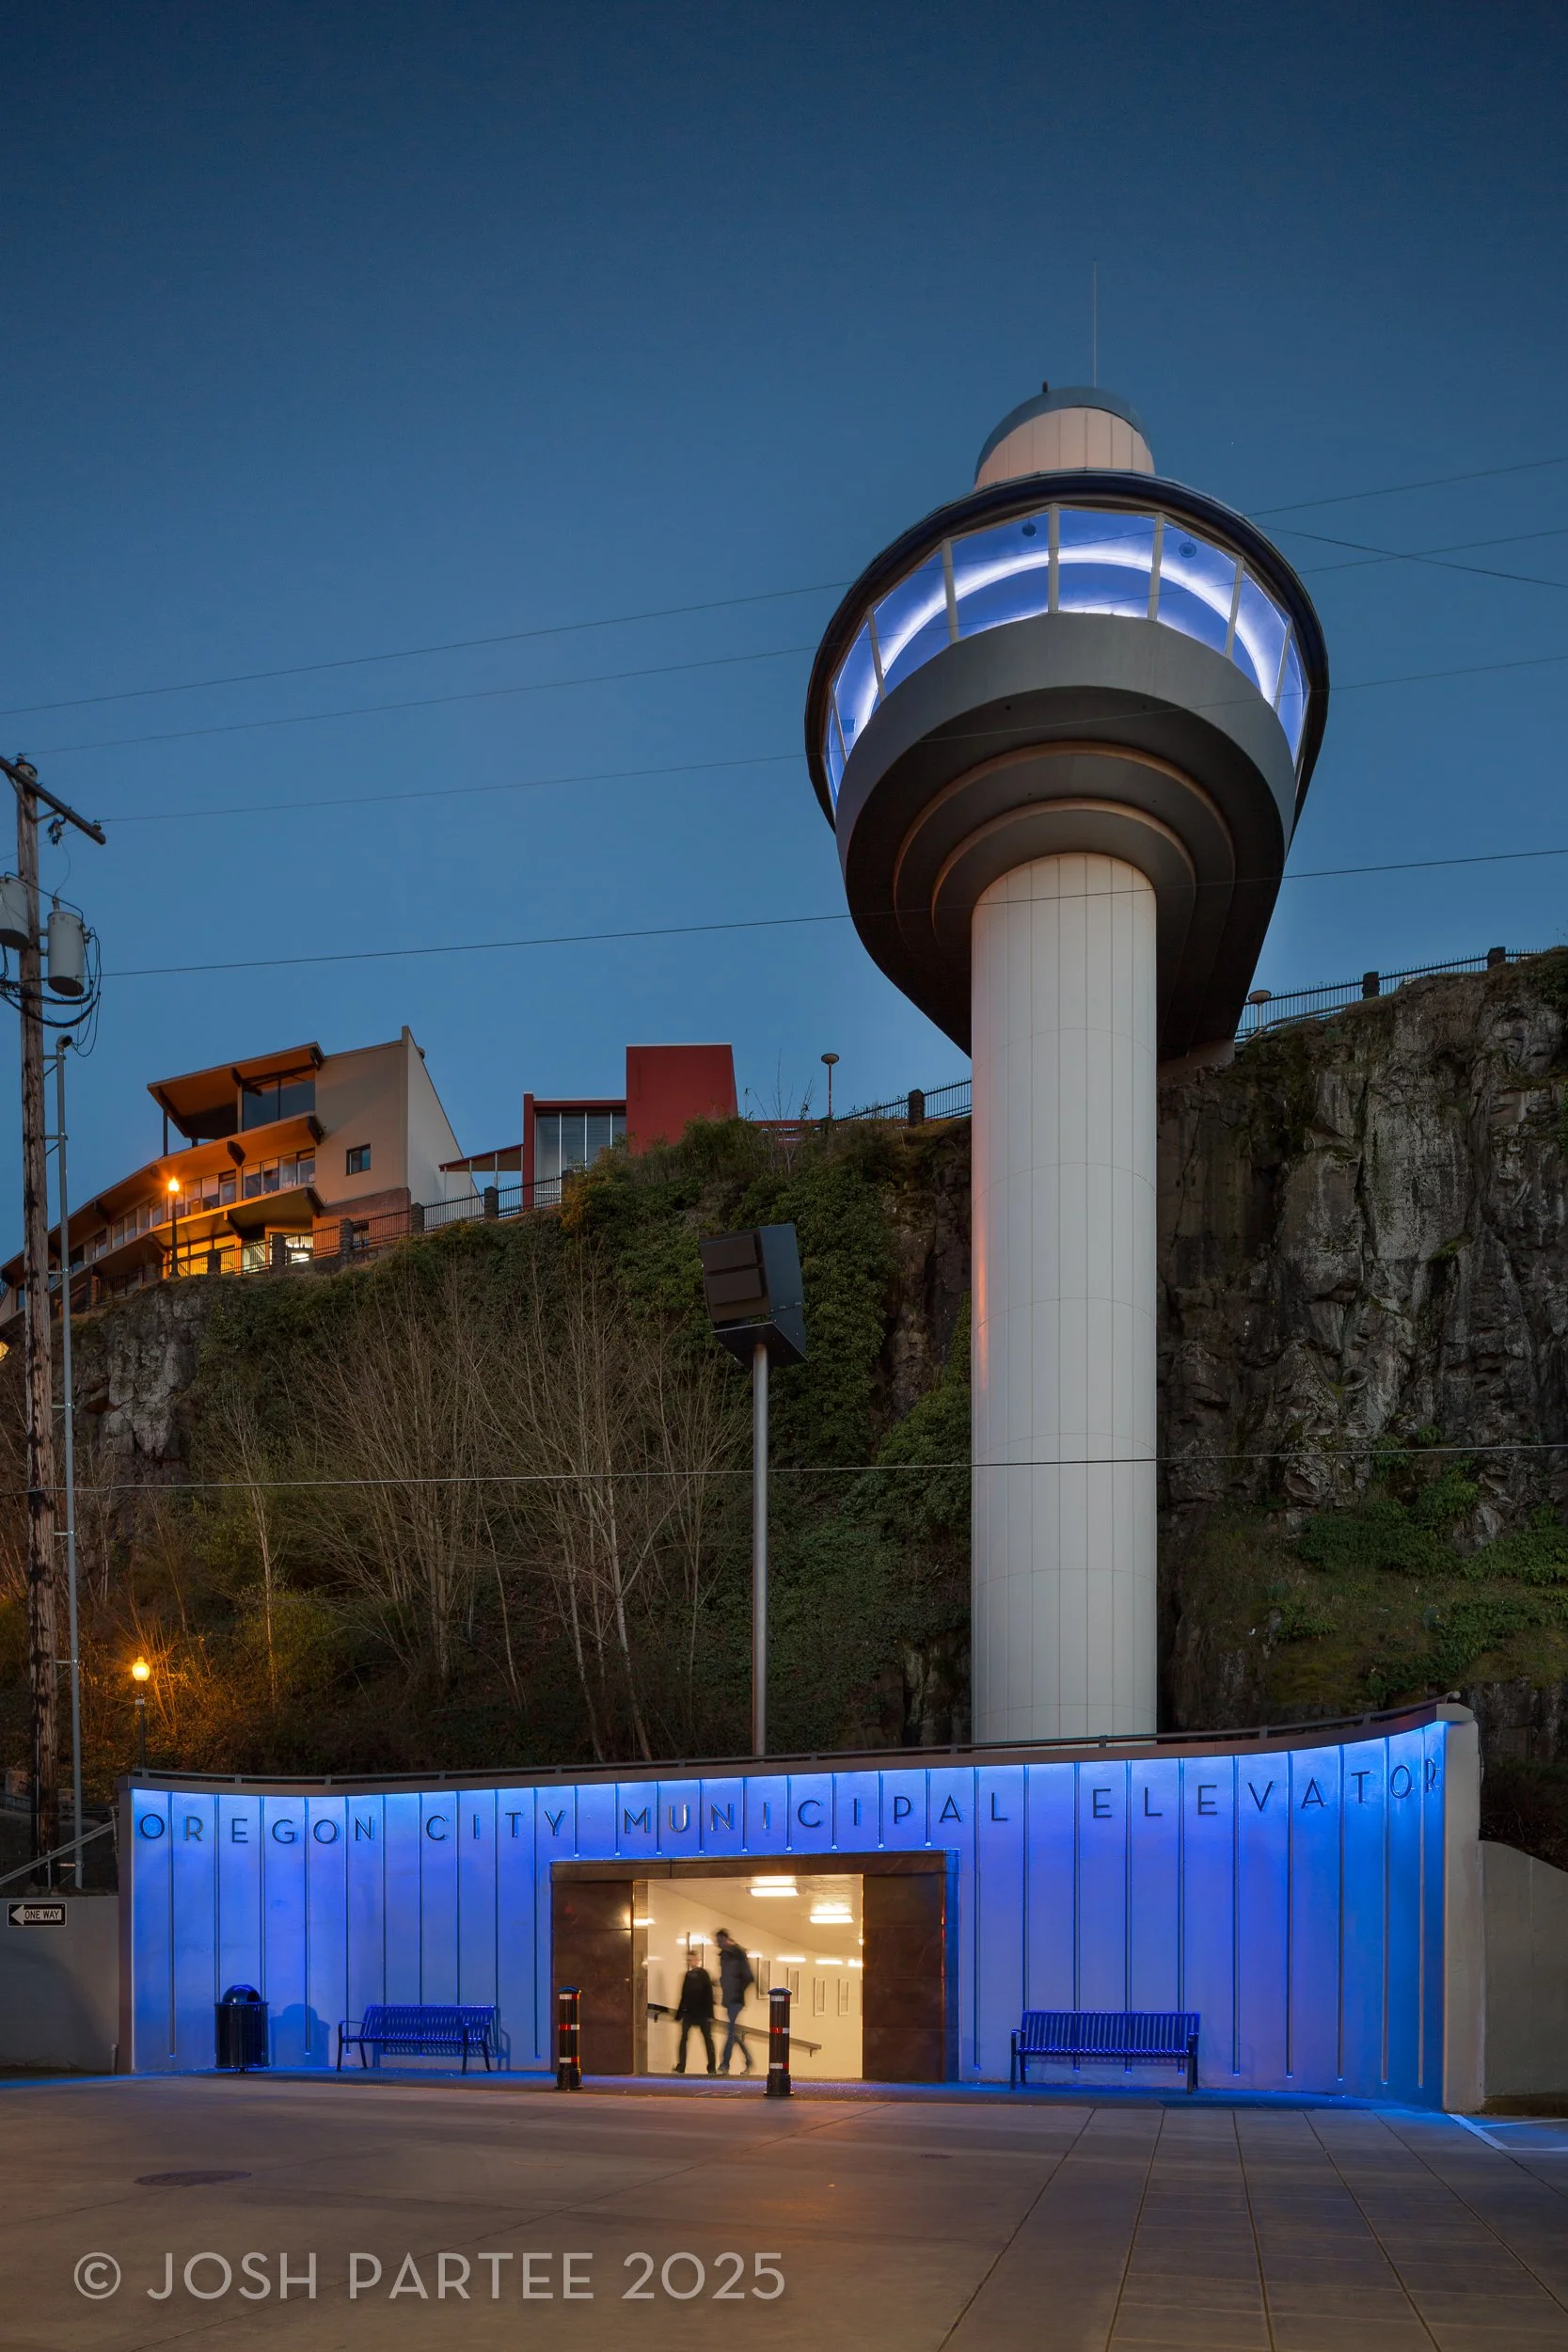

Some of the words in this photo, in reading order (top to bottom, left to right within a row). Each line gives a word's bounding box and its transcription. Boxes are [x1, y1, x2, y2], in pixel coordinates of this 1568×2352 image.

[139, 1812, 373, 1845] OREGON
[425, 1809, 564, 1842] CITY
[624, 1791, 1008, 1834] MUNICIPAL
[1092, 1757, 1440, 1819] ELEVATOR
[24, 1910, 40, 1920] ONE
[42, 1910, 59, 1920] WAY
